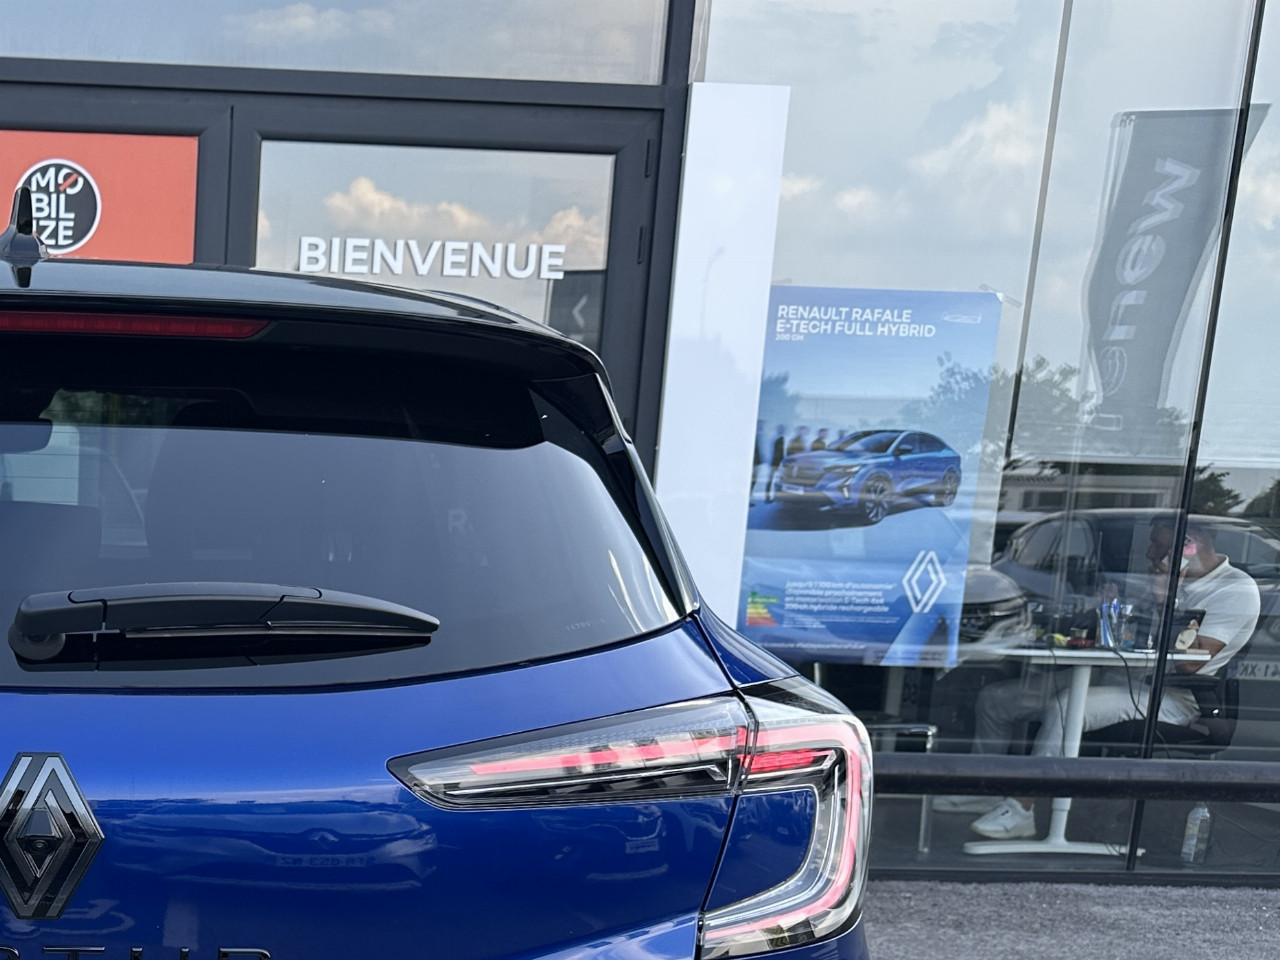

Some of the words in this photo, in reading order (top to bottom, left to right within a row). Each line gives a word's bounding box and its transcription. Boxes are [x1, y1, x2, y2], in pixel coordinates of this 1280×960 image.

[298, 236, 567, 280] BIENVENUE
[777, 304, 850, 320] RENAULT
[851, 307, 912, 323] RAFALE
[775, 319, 832, 335] E-TECH
[834, 321, 874, 336] FULL
[876, 323, 937, 338] HYBRID
